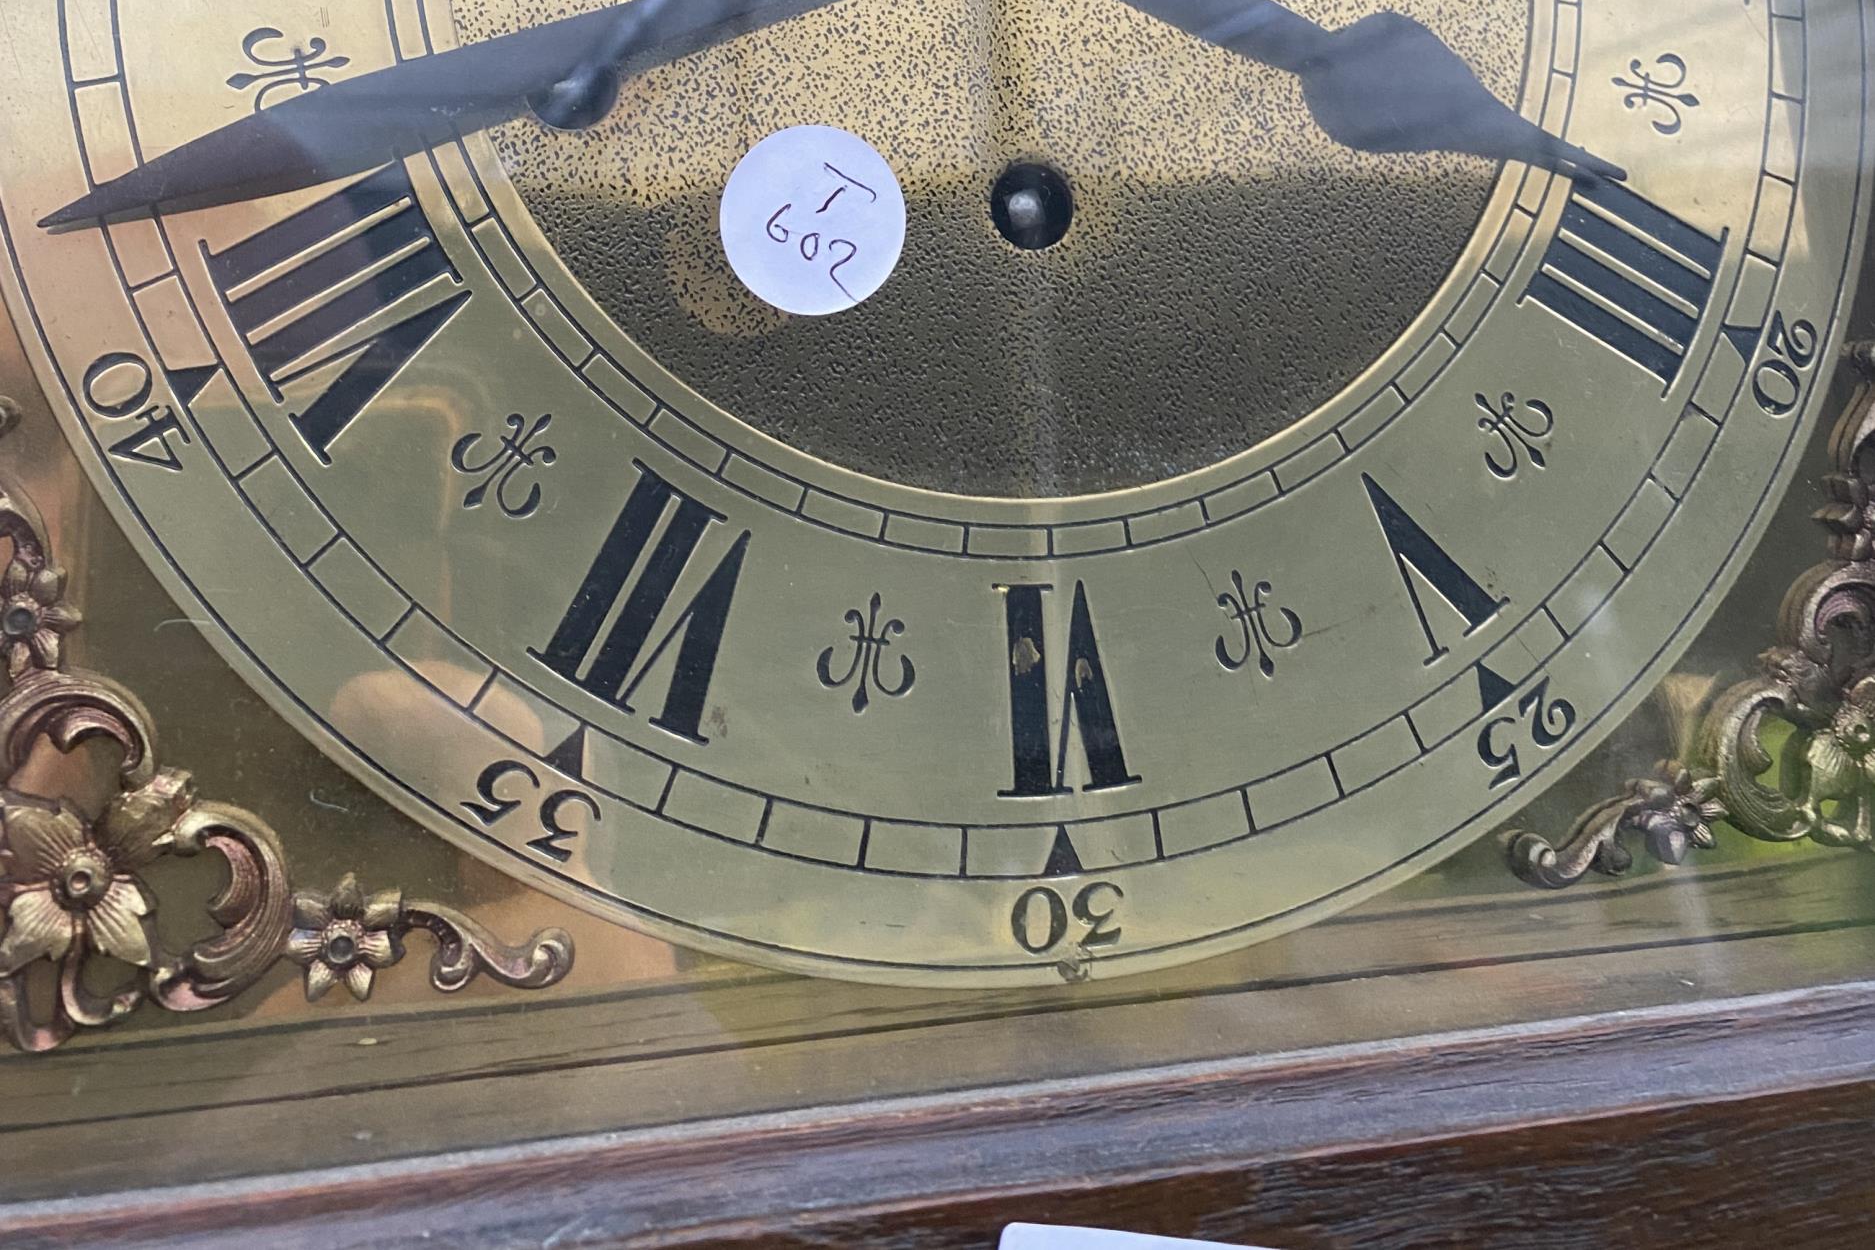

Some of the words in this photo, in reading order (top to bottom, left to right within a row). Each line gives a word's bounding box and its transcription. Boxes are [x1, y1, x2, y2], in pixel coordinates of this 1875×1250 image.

[200, 162, 472, 466] VIII
[1515, 172, 1730, 398] IIII
[1751, 310, 1817, 415] 20
[83, 350, 185, 472] 40
[524, 457, 752, 746] VII
[1360, 470, 1513, 667] V
[992, 579, 1142, 799] VI
[1476, 675, 1577, 791] 25
[460, 759, 602, 863] 35
[1010, 881, 1124, 955] 30
